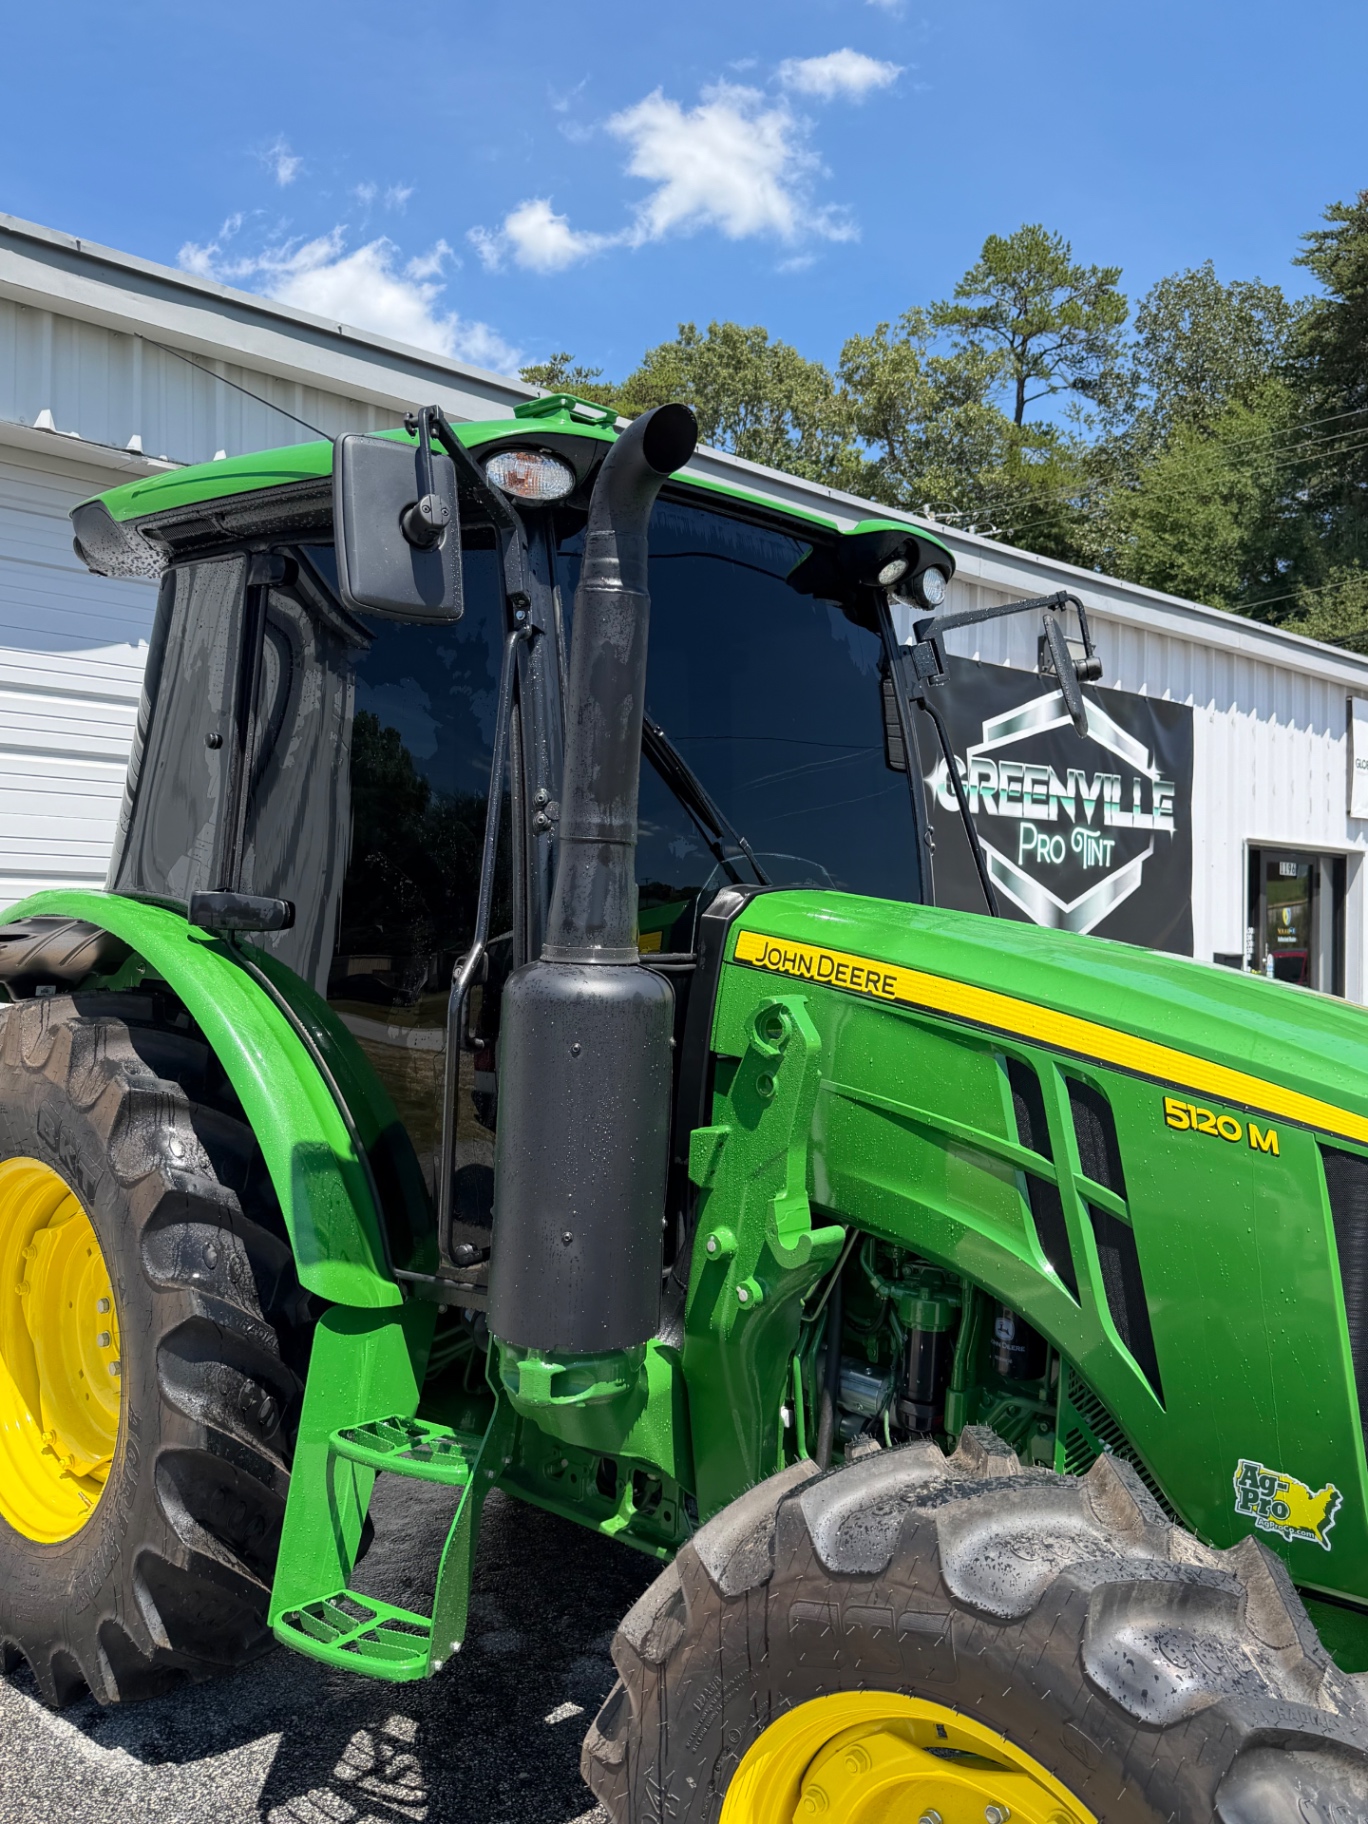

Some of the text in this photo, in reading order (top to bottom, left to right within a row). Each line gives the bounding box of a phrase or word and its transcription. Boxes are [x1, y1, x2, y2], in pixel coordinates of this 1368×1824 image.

[937, 755, 1175, 829] GREENVILLE
[1280, 862, 1296, 875] 1196
[755, 941, 898, 996] JOHN DEERE
[1163, 1096, 1280, 1157] 5120 M
[1238, 1463, 1288, 1498] Ag-
[1238, 1487, 1289, 1519] Pro
